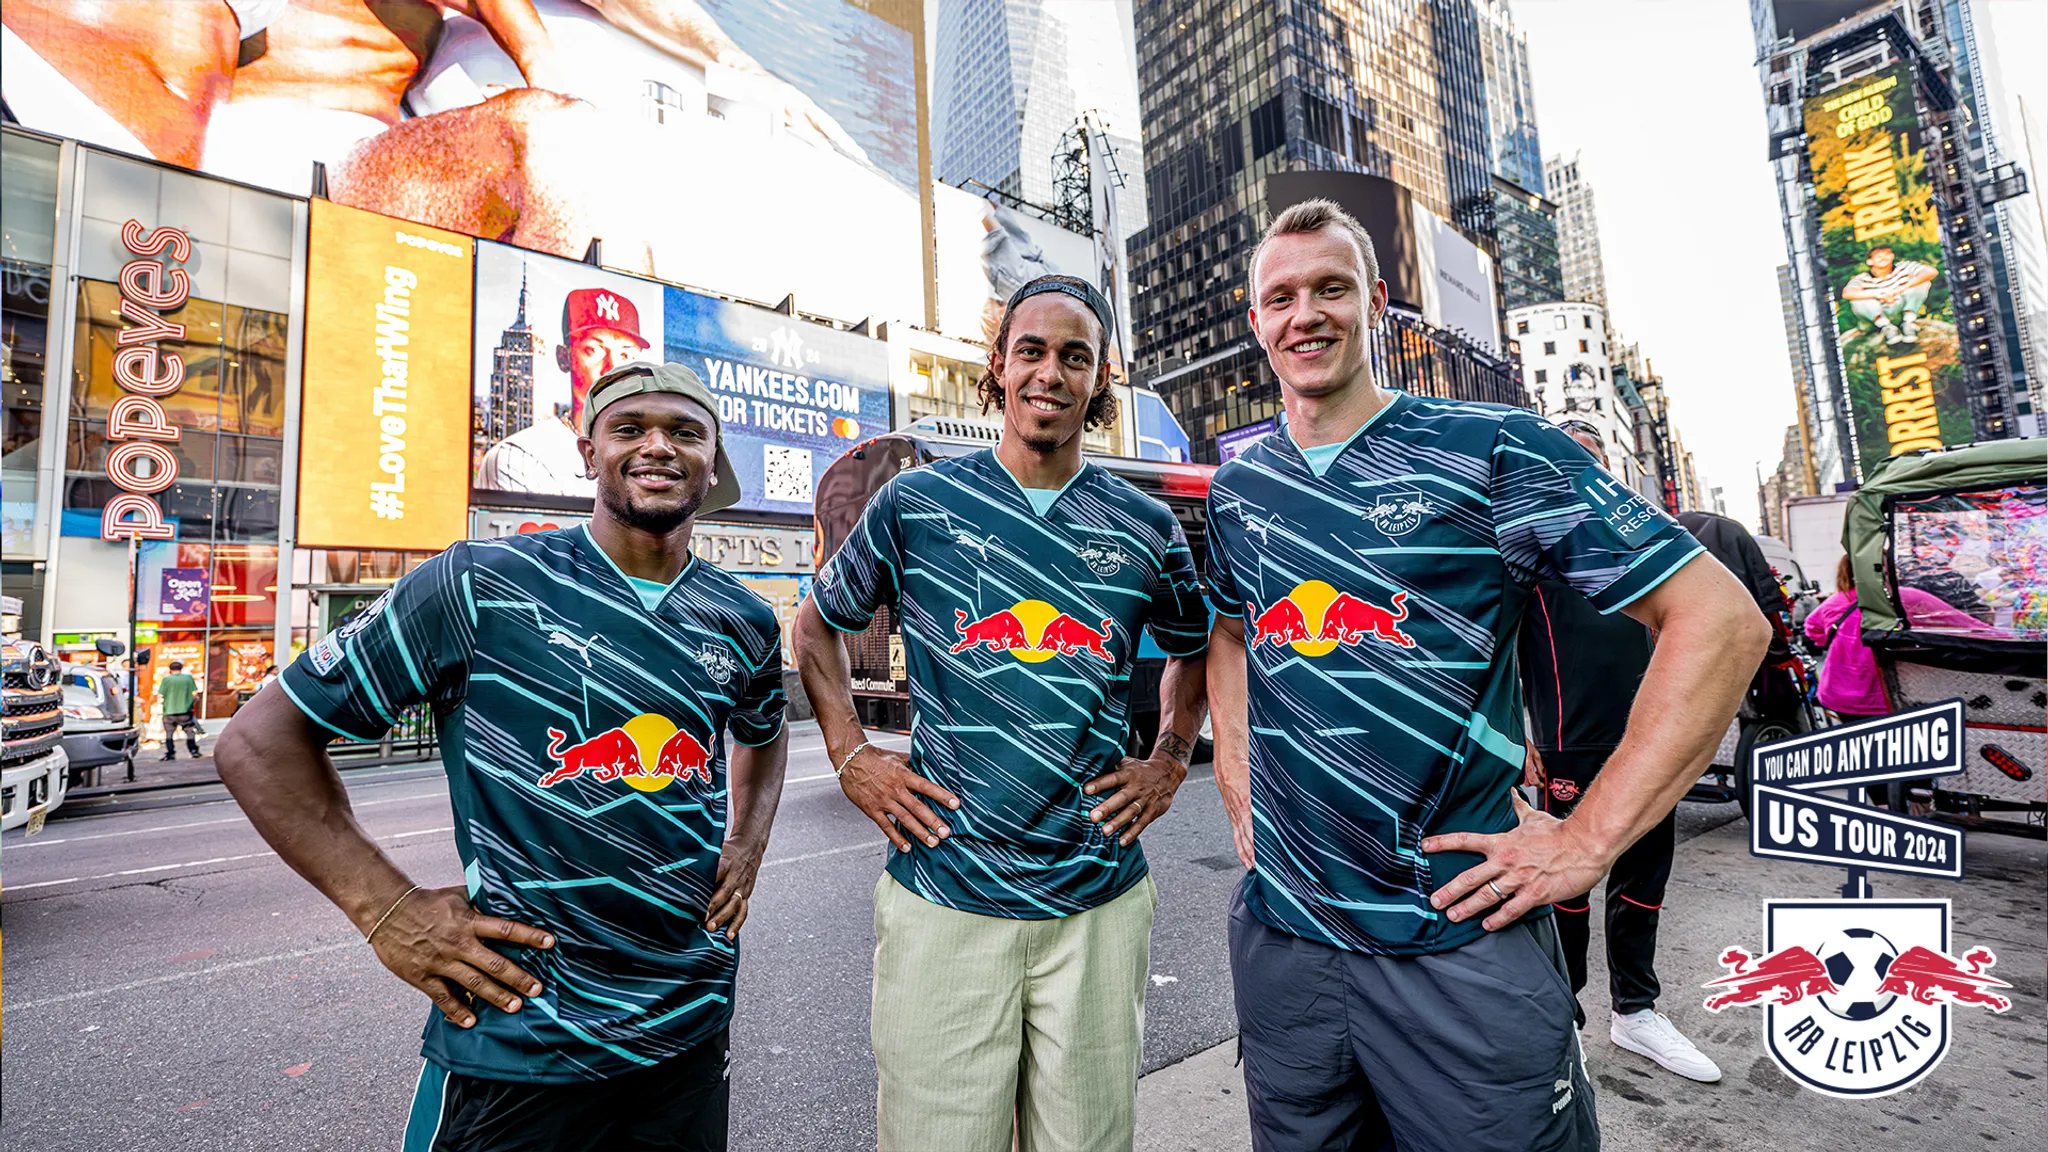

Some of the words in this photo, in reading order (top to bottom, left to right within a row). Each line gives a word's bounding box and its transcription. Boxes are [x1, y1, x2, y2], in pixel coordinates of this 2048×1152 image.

[1835, 119, 1857, 139] OF
[1856, 105, 1893, 132] GOD
[1838, 94, 1885, 123] CHILD
[1843, 135, 1904, 243] FRANK
[370, 265, 418, 520] #LoveThatWing
[704, 357, 860, 414] YANKEES.COM
[751, 401, 828, 436] TICKETS
[1876, 352, 1943, 456] ORREST
[1585, 472, 1628, 506] IH
[1604, 494, 1646, 525] HOTE
[1617, 506, 1659, 537] RESO
[692, 533, 785, 565] IFTS
[168, 578, 202, 588] Open
